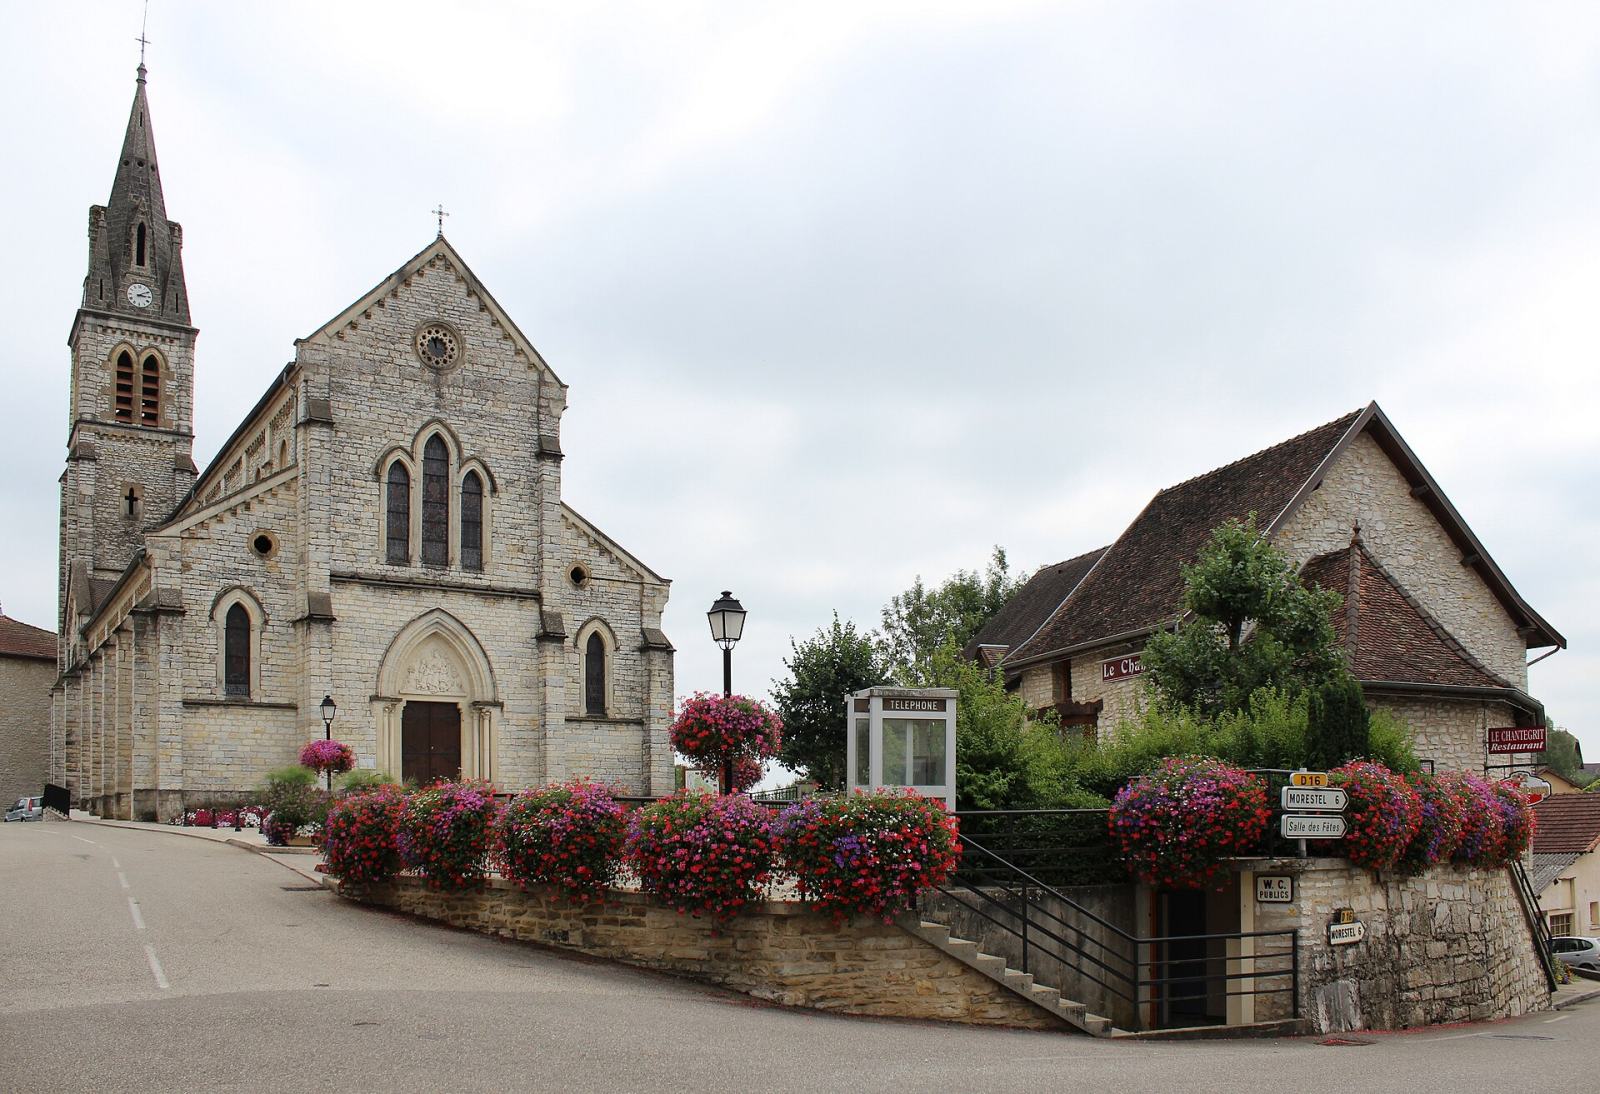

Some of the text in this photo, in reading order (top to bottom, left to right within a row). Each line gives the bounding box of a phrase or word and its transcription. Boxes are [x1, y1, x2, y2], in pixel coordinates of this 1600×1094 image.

[1104, 664, 1114, 677] Le
[891, 700, 938, 710] TELEPHONE
[1491, 729, 1544, 742] LE CHANTEGRIT
[1490, 741, 1544, 751] Restaurant
[1301, 776, 1320, 785] D16
[1289, 793, 1340, 805] MORESTEL 6
[1288, 821, 1339, 832] Salle des Fêtes
[1263, 880, 1287, 889] W. C.
[1260, 891, 1289, 899] PUBLICS
[1331, 927, 1362, 939] MORESTEL 6
